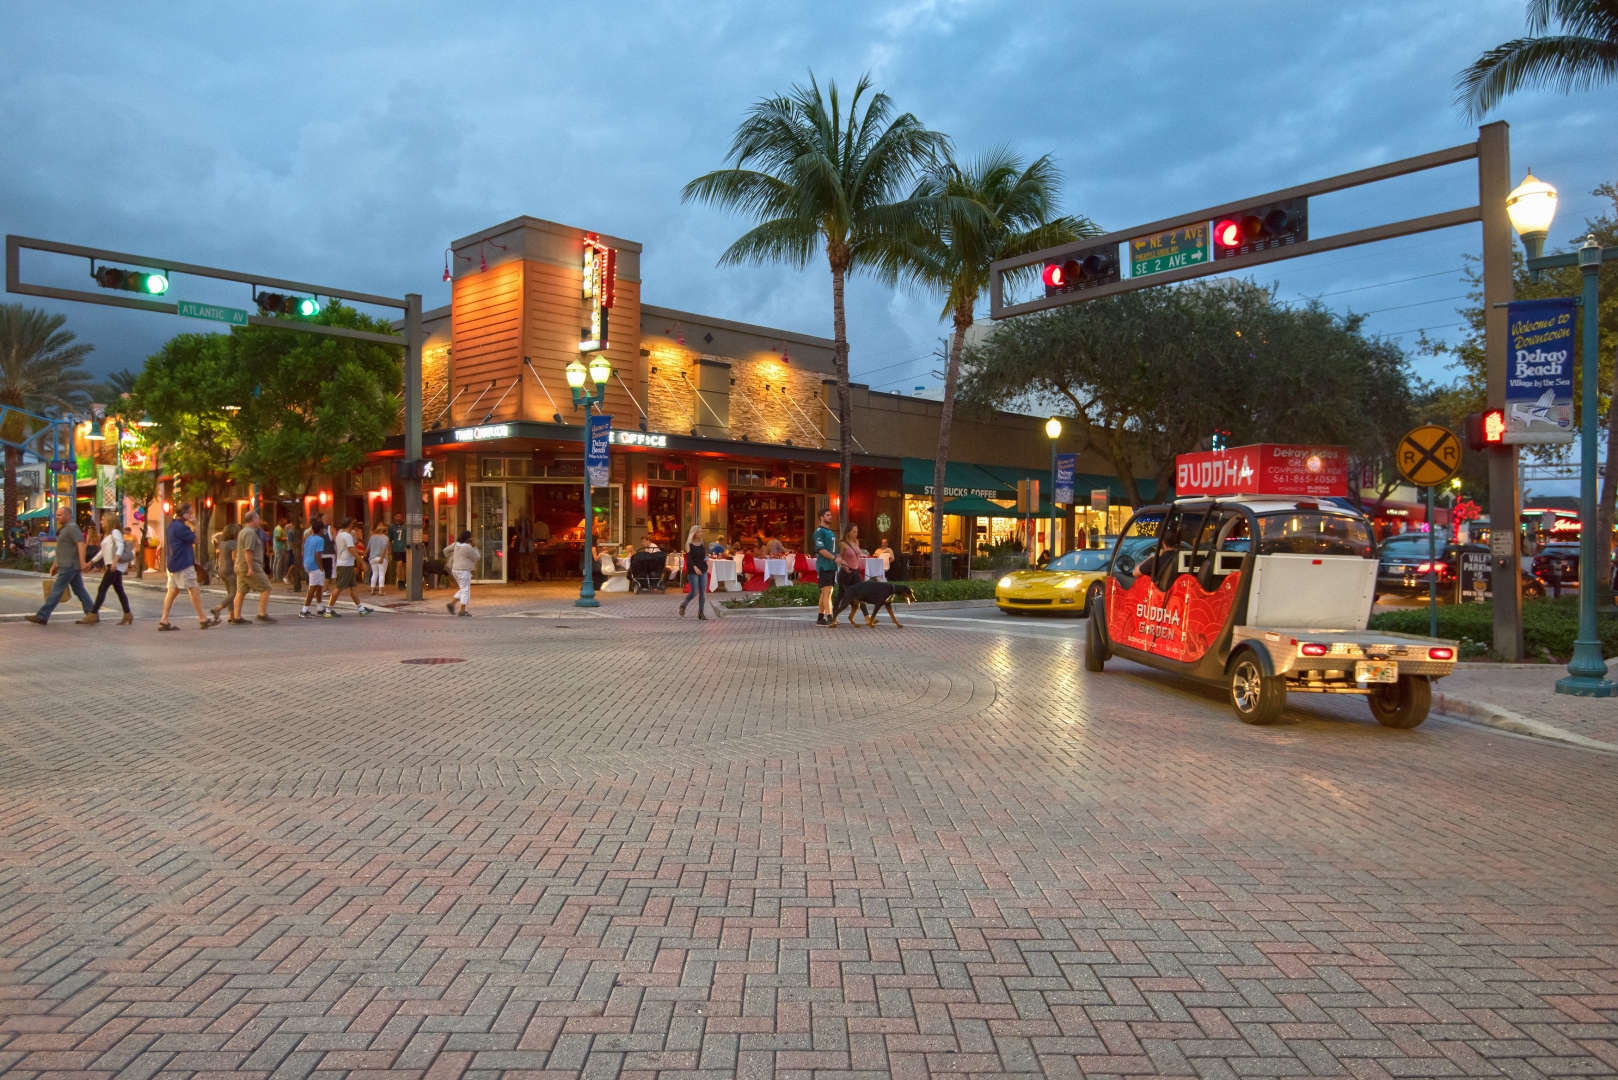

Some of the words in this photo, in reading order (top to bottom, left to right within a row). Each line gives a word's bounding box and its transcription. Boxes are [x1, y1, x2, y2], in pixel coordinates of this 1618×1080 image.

[1150, 236, 1163, 249] NE
[1170, 232, 1177, 245] 2
[1185, 226, 1203, 241] AVE
[1136, 262, 1148, 275] SE
[1155, 259, 1161, 271] 2
[1169, 253, 1187, 268] AVE
[182, 304, 225, 320] ATLANTIC
[233, 312, 244, 323] AV
[1511, 317, 1555, 336] Welcome
[1557, 313, 1570, 325] to
[1513, 328, 1571, 350] Downtown
[1515, 348, 1567, 364] Delray
[1514, 361, 1562, 378] Beach
[1509, 379, 1533, 388] Village
[1534, 379, 1542, 388] by
[1555, 378, 1570, 386] Sea
[620, 431, 667, 448] OFFICE
[1273, 447, 1309, 460] Delray
[1310, 448, 1339, 458] Rides
[1404, 451, 1416, 464] R
[1444, 447, 1456, 460] R
[1178, 454, 1253, 489] BUDDHA
[1273, 475, 1337, 484] 561-865-6058
[396, 529, 403, 541] 7
[831, 536, 836, 553] 7
[1136, 603, 1181, 627] BUDDHA
